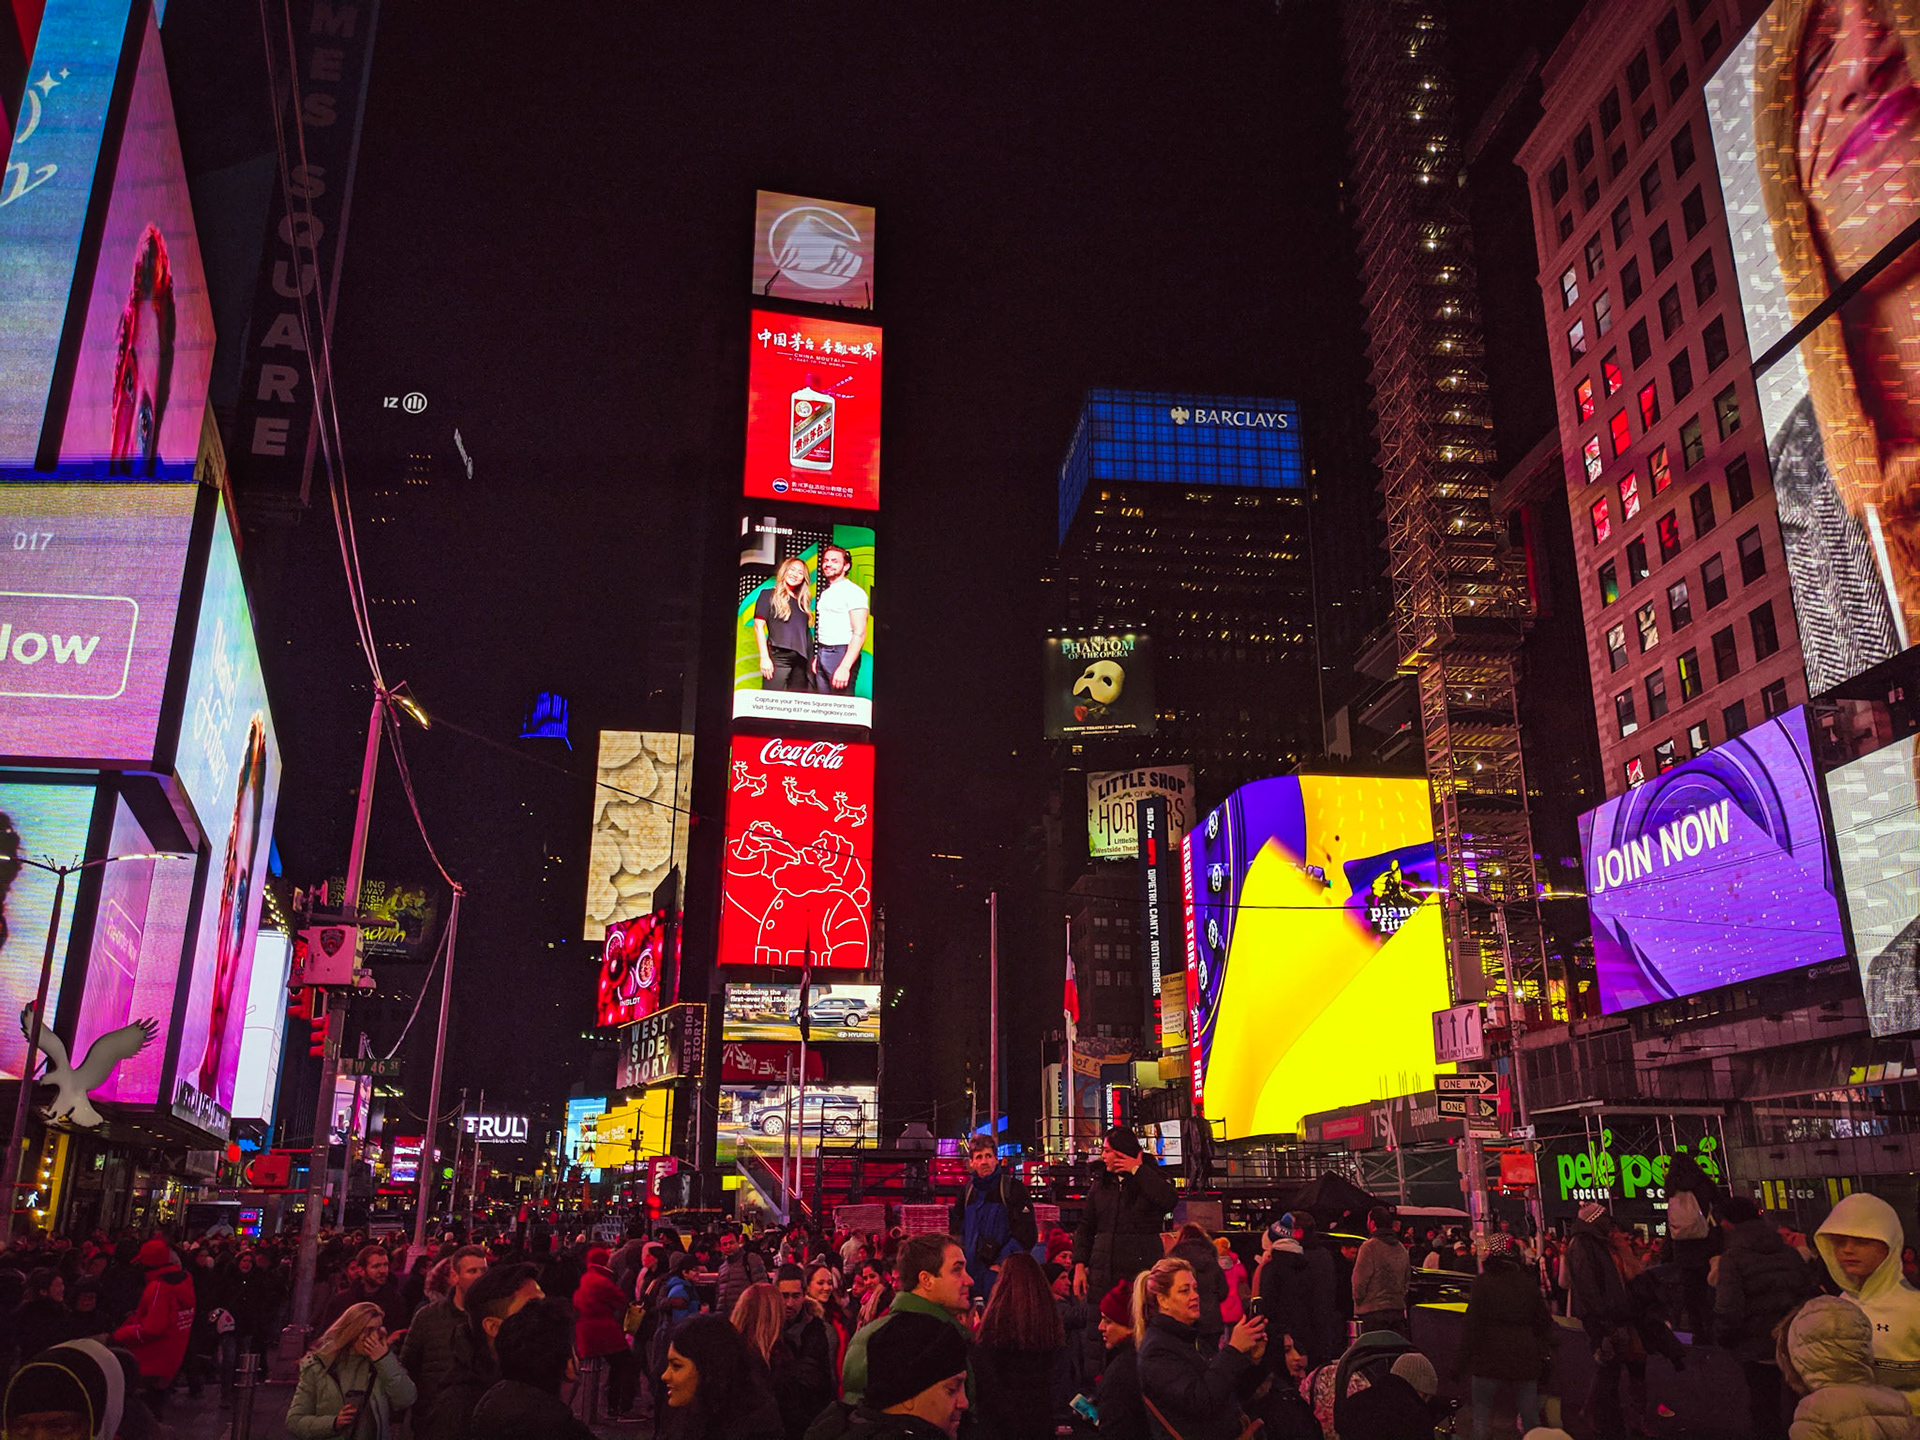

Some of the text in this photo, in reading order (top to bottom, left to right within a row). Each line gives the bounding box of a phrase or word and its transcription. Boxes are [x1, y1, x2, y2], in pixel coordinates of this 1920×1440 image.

[251, 164, 327, 457] SQUARE
[757, 328, 814, 352] 中国茅台
[794, 352, 841, 363] CHINA MOUTAI
[1195, 409, 1288, 429] BARCLAYS
[755, 525, 793, 535] SAMSUNG
[1062, 640, 1134, 654] PHANTOM
[1100, 650, 1128, 658] OPERA
[754, 696, 779, 704] Capture
[765, 705, 792, 713] Samsung
[811, 708, 857, 717] withgalaxy.com
[760, 738, 848, 769] Coca-Cola
[1098, 771, 1186, 800] LITTLE SHOP
[1098, 798, 1186, 846] HORRS
[1095, 845, 1121, 853] Westside
[1594, 799, 1730, 893] JOIN NOW
[1370, 903, 1418, 922] plane
[1186, 921, 1197, 972] STORE
[619, 997, 641, 1007] INGLOT
[731, 989, 769, 997] Introducing
[631, 1014, 668, 1043] WEST
[631, 1035, 665, 1063] SIDE
[682, 1006, 694, 1074] WEST SIDE
[692, 1018, 702, 1062] STORY
[1465, 1046, 1479, 1055] ONLY
[355, 1060, 365, 1073] W
[370, 1061, 386, 1074] 46
[625, 1055, 670, 1085] STORY
[1193, 1059, 1203, 1098] FREE
[1443, 1080, 1488, 1089] ONE WAY
[1410, 1105, 1439, 1127] BROADWA
[1445, 1102, 1464, 1111] ONE
[1557, 1128, 1721, 1201] pelé peé
[1572, 1188, 1611, 1200] SOCCER
